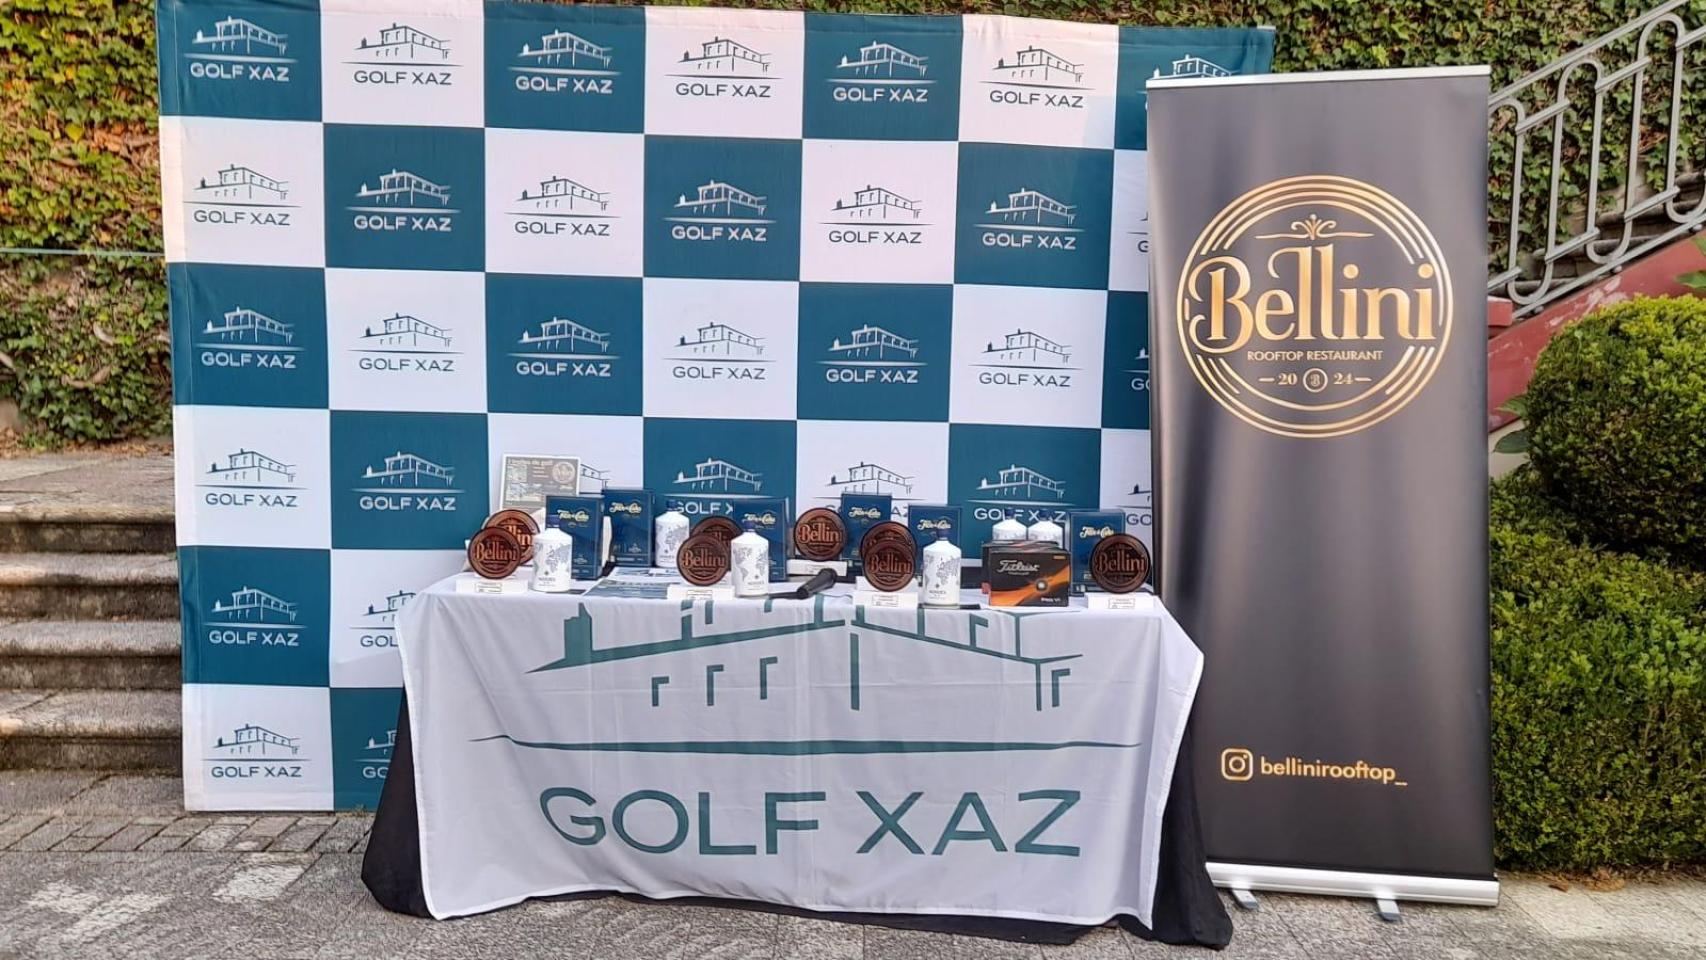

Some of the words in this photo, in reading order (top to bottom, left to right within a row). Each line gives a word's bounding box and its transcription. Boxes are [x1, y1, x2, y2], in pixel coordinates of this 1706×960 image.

[190, 63, 243, 80] GOLF
[248, 66, 290, 82] XAZ
[353, 70, 408, 84] GOLF
[412, 71, 452, 86] XAZ
[515, 75, 568, 92] GOLF
[573, 78, 613, 94] XAZ
[675, 82, 728, 97] GOLF
[731, 84, 771, 98] XAZ
[833, 86, 885, 102] GOLF
[889, 88, 928, 103] XAZ
[989, 89, 1041, 105] GOLF
[1044, 92, 1085, 109] XAZ
[193, 209, 246, 224] GOLF
[250, 212, 291, 226] XAZ
[353, 215, 407, 230] GOLF
[411, 217, 452, 232] XAZ
[514, 220, 567, 235] GOLF
[571, 223, 610, 237] XAZ
[671, 225, 724, 241] GOLF
[728, 227, 767, 242] XAZ
[828, 230, 880, 244] GOLF
[883, 231, 922, 244] XAZ
[982, 232, 1034, 248] GOLF
[1037, 235, 1076, 250] XAZ
[1187, 243, 1437, 354] Bellini
[201, 351, 253, 367] GOLF
[256, 353, 297, 370] XAZ
[1247, 350, 1304, 361] ROOFTOP
[1306, 350, 1384, 361] RESTAURANT
[358, 357, 411, 371] GOLF
[415, 359, 455, 372] XAZ
[516, 361, 568, 376] GOLF
[572, 362, 611, 377] XAZ
[672, 366, 724, 379] GOLF
[727, 367, 766, 380] XAZ
[825, 368, 877, 383] GOLF
[880, 369, 918, 384] XAZ
[978, 372, 1029, 386] GOLF
[1033, 374, 1071, 388] XAZ
[1278, 372, 1298, 386] 20
[1333, 372, 1354, 385] 24
[205, 492, 255, 506] GOLF
[258, 494, 297, 508] XAZ
[359, 496, 412, 511] GOLF
[416, 497, 456, 511] XAZ
[1028, 509, 1067, 523] XZ
[1126, 513, 1152, 526] GO
[799, 522, 844, 544] Bellini
[474, 541, 518, 562] Bellini
[869, 551, 912, 574] Bellini
[1095, 550, 1147, 574] Bellini
[208, 630, 258, 645] GOLF
[261, 632, 299, 647] XAZ
[360, 635, 399, 648] GOL
[211, 766, 260, 778] GOLF
[263, 766, 302, 778] XAZ
[362, 766, 389, 779] GO
[1260, 755, 1409, 786] bellinirooftop_
[538, 786, 827, 857] GOLF
[855, 789, 1082, 858] XAZ
